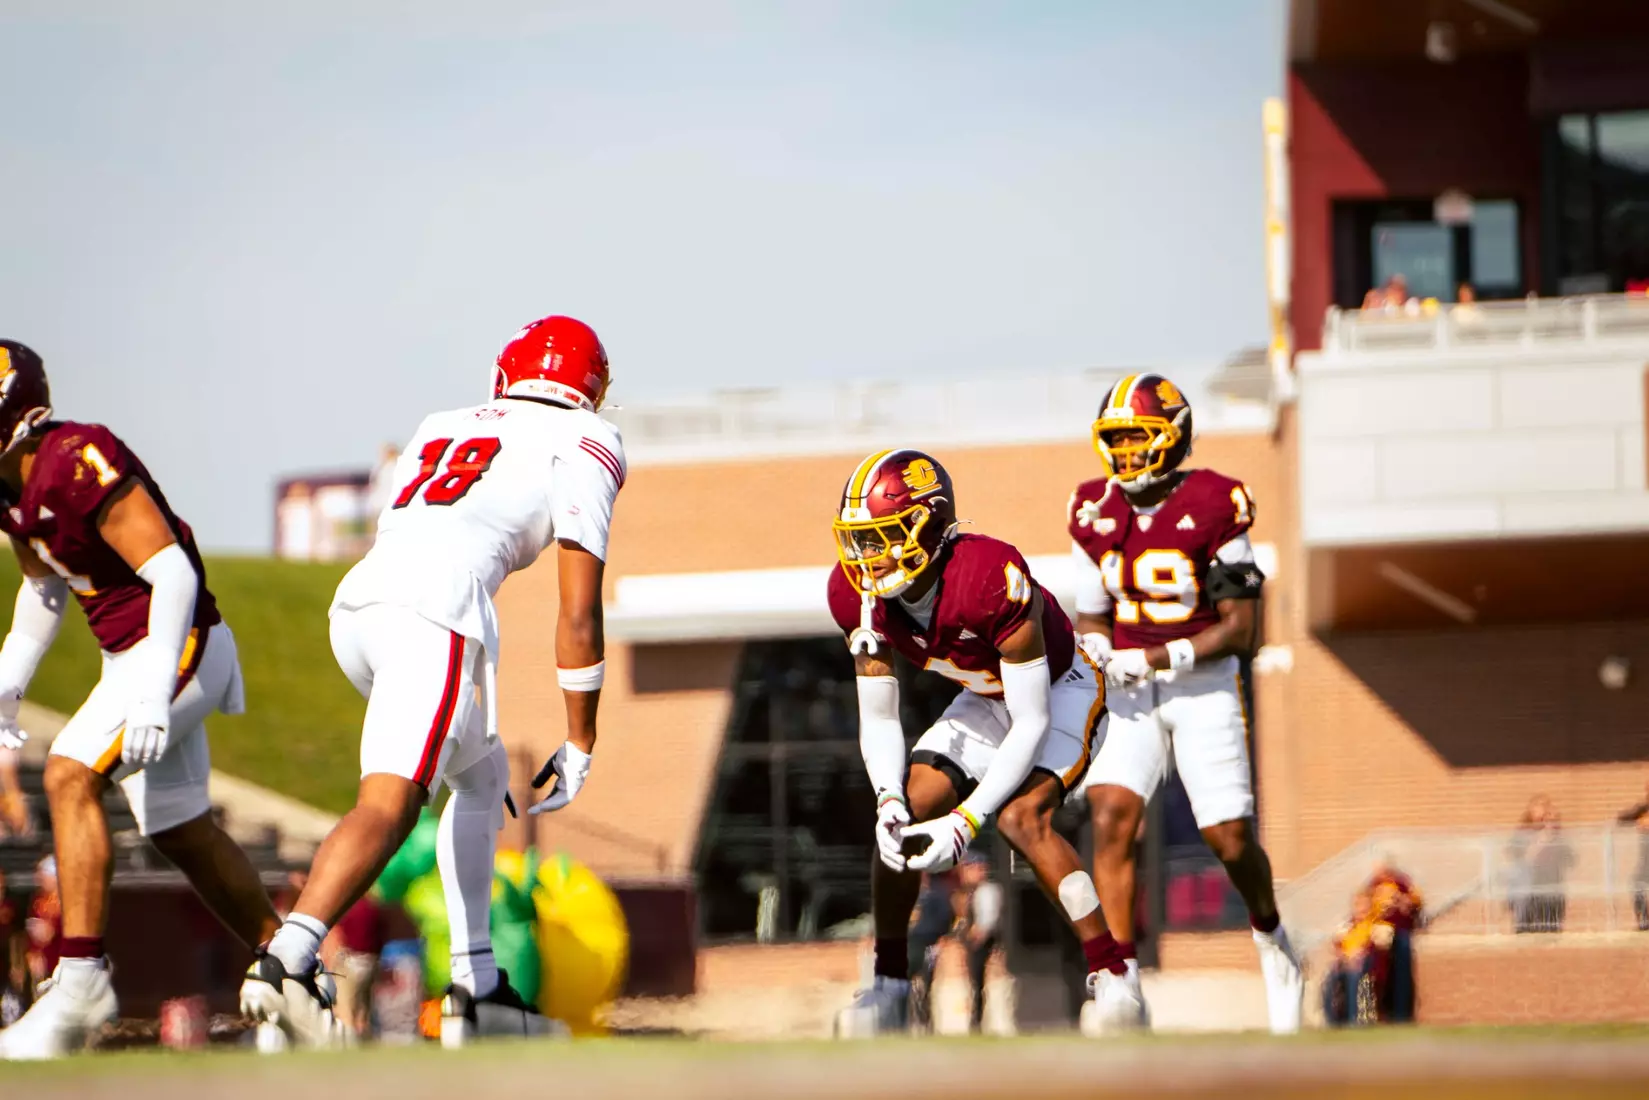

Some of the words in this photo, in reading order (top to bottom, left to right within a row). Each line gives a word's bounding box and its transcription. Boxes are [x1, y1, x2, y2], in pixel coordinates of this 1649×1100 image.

[82, 443, 120, 487] 1
[392, 437, 502, 509] 18
[29, 537, 98, 596] 1
[1100, 548, 1200, 624] 19
